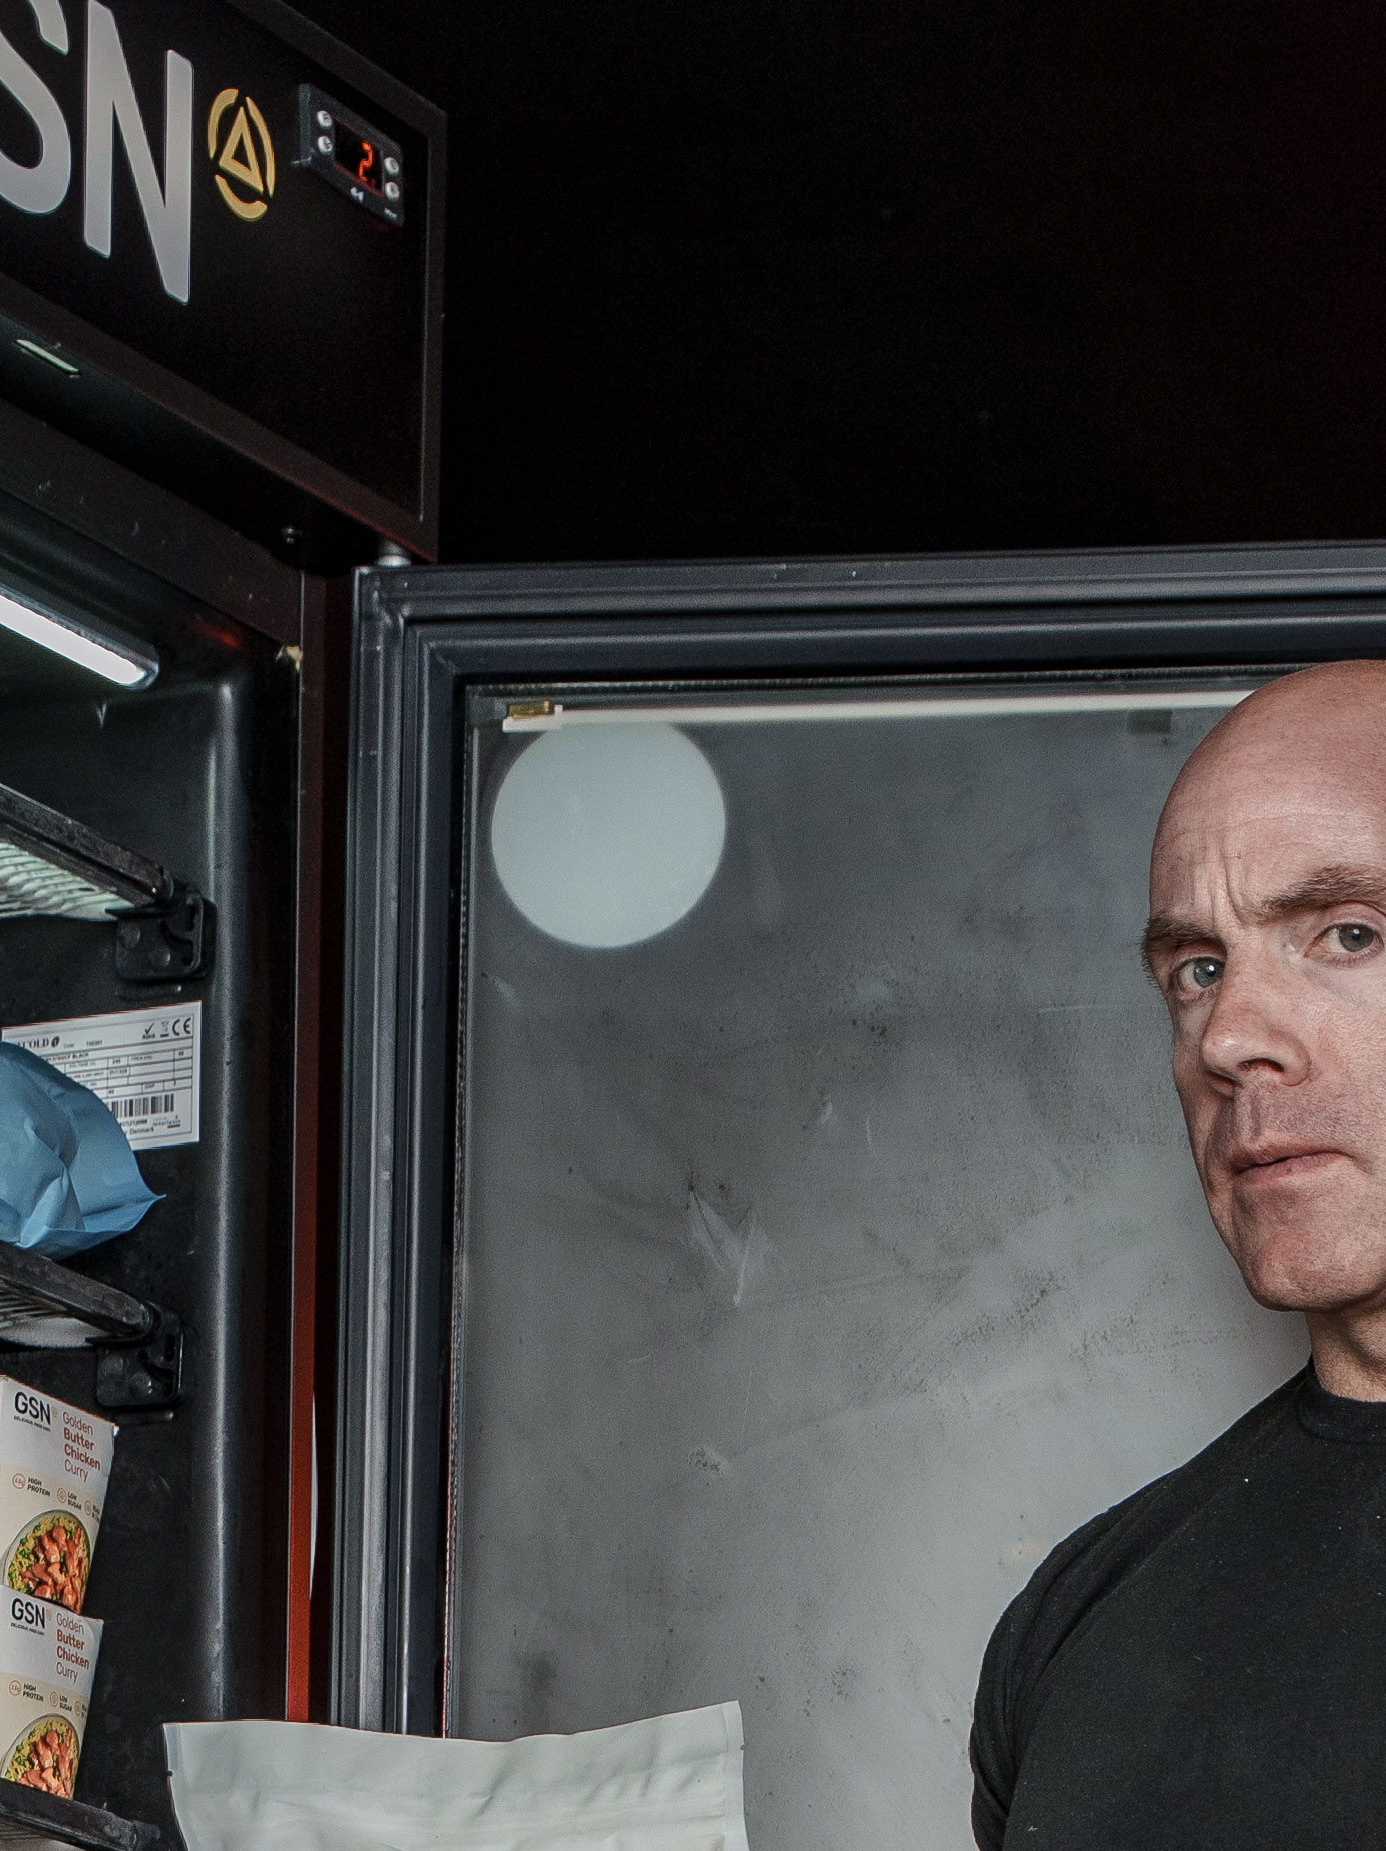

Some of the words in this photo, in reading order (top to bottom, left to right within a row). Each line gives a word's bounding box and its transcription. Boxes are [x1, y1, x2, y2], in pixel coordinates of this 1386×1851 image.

[14, 1391, 51, 1426] GSN
[62, 1411, 94, 1436] Golden
[64, 1428, 95, 1451] Butter
[64, 1444, 101, 1471] Chicken
[64, 1459, 89, 1483] Curry
